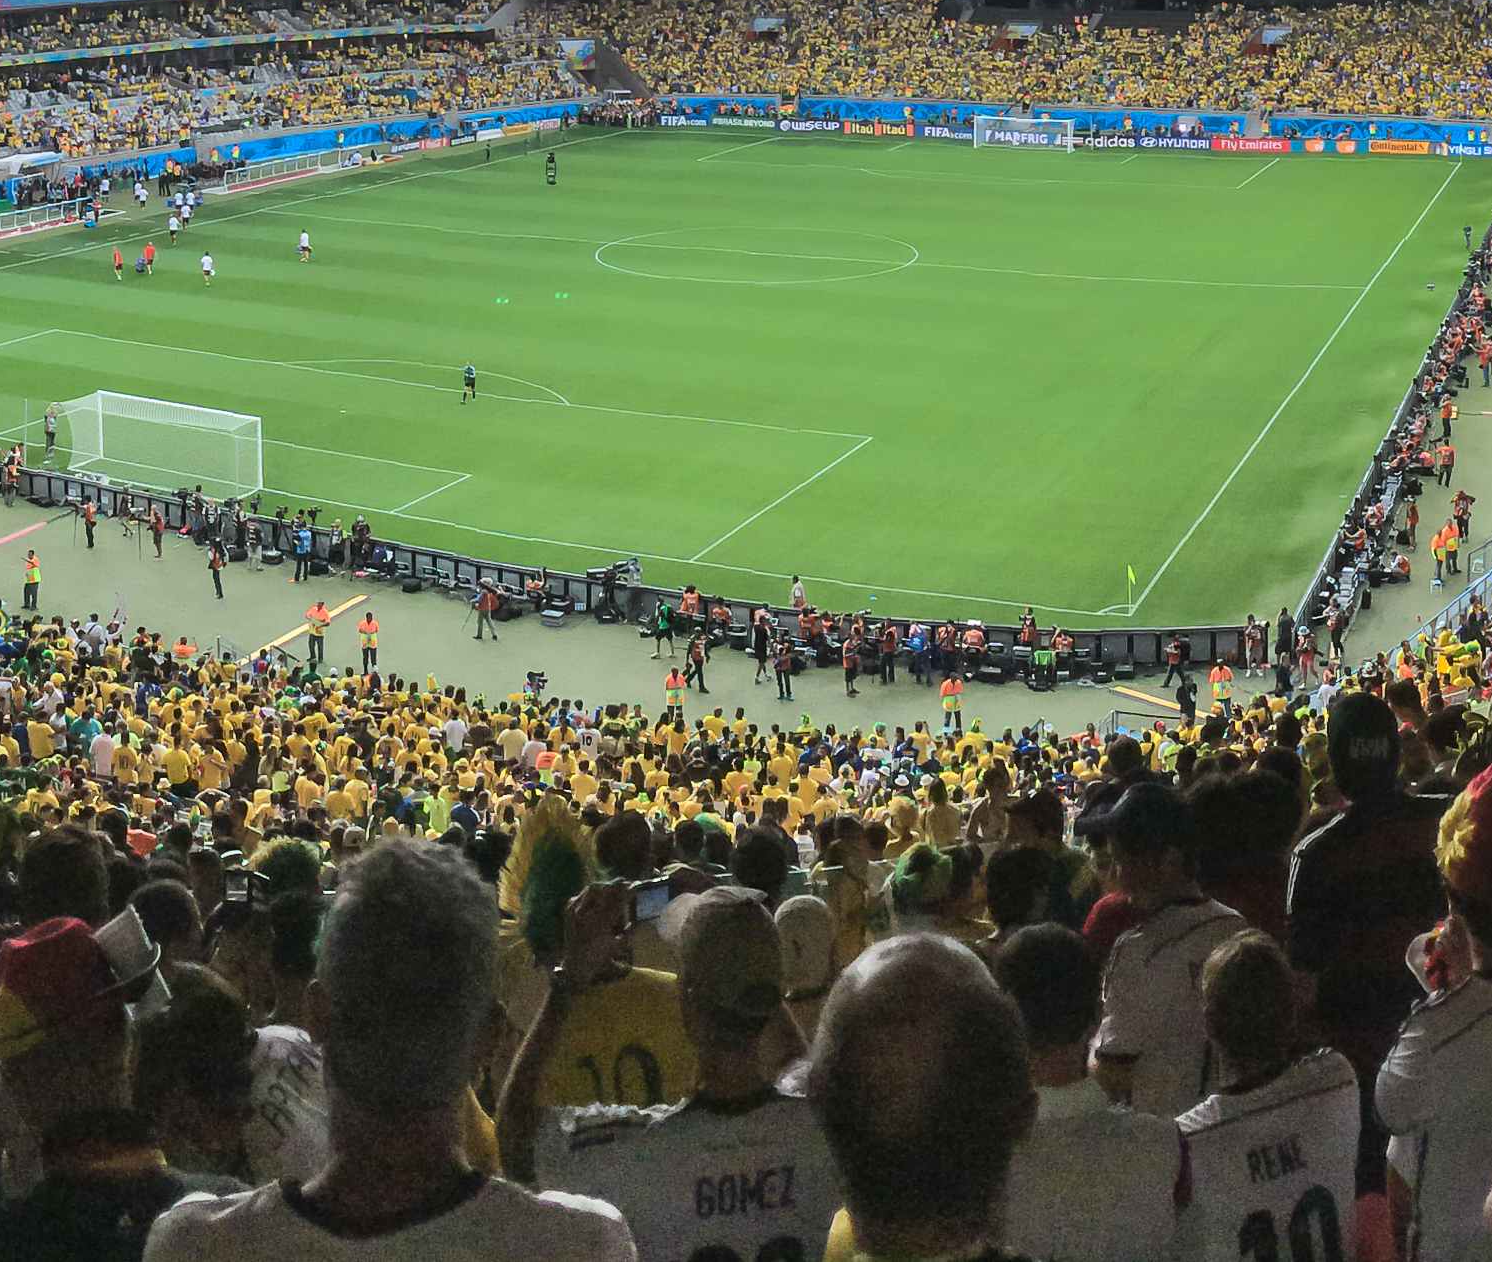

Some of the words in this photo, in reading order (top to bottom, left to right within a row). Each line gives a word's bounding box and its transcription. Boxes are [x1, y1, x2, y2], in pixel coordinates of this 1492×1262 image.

[851, 121, 873, 135] Itaú
[882, 122, 905, 135] Itaú
[994, 131, 1048, 146] MARFRIG
[1084, 135, 1135, 148] adidas
[1158, 138, 1210, 149] HYUNDAI
[1220, 139, 1238, 152] Fly
[1239, 139, 1283, 150] Emirates
[1447, 145, 1482, 156] YINGLI
[582, 734, 593, 747] 10
[118, 755, 130, 769] 10
[695, 1165, 798, 1219] GOMEZ
